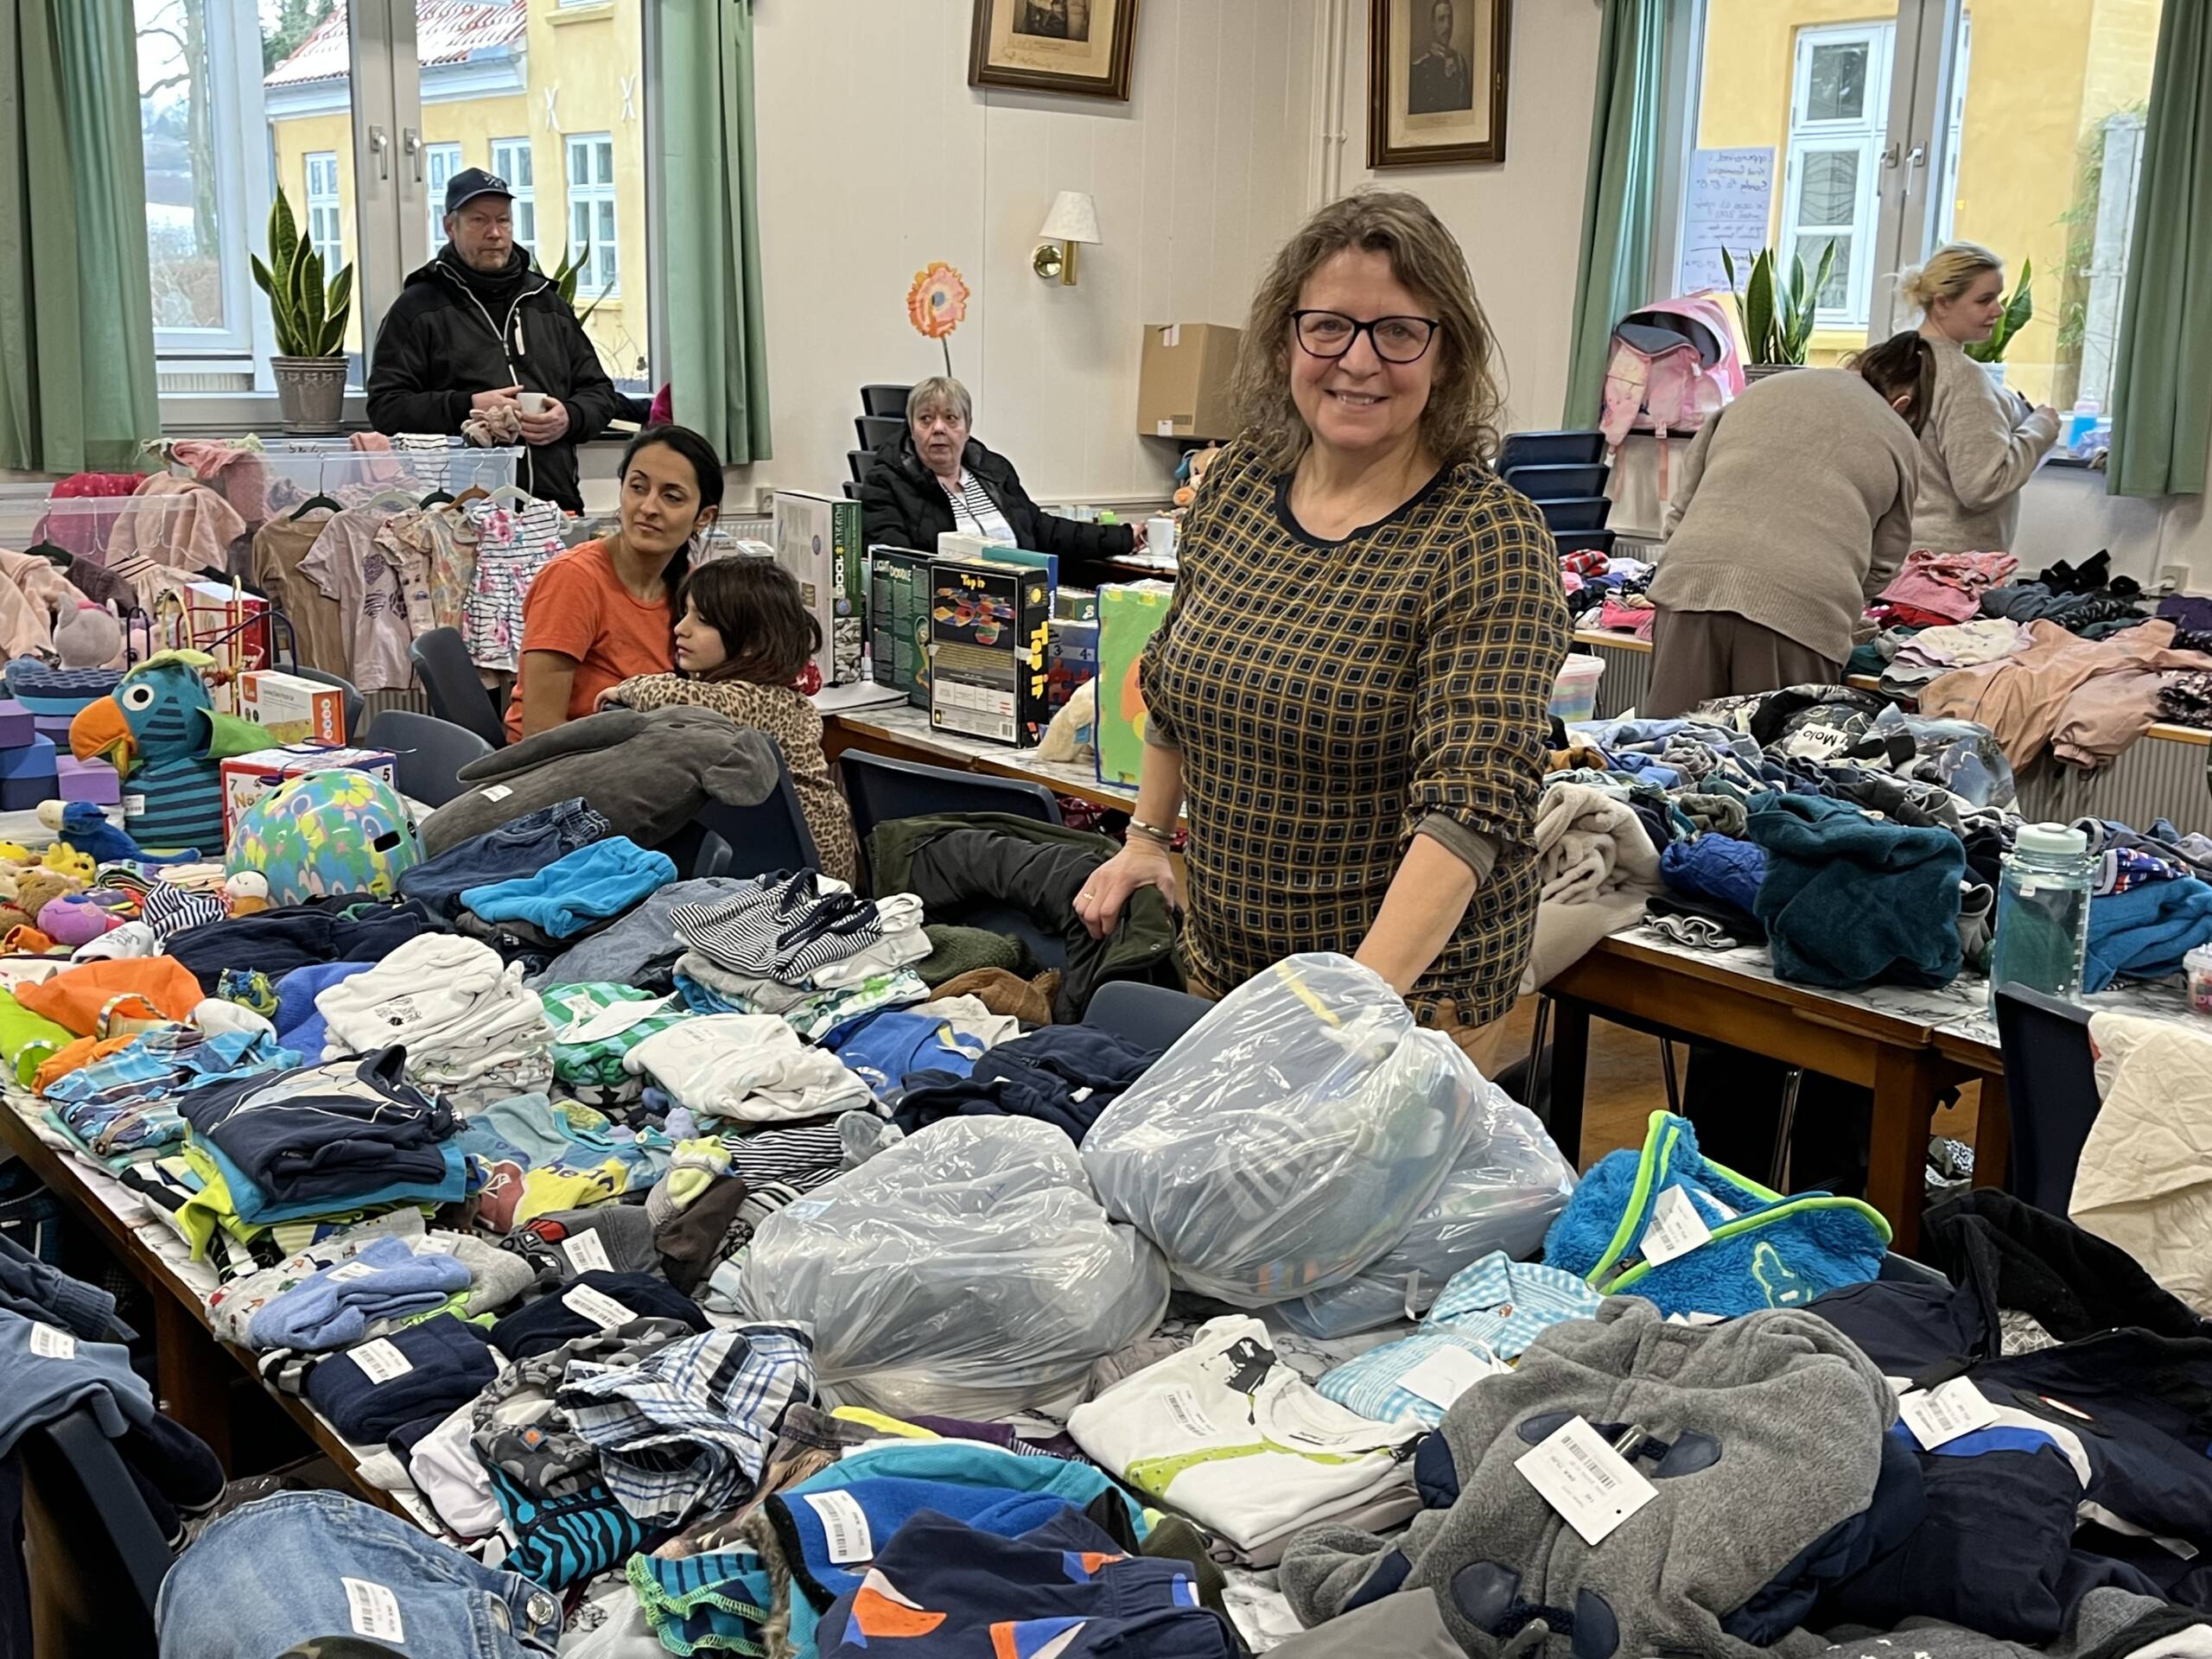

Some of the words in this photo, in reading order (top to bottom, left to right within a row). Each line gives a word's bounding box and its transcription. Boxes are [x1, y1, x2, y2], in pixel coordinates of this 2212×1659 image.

[835, 556, 845, 595] 1000
[1802, 730, 1838, 747] Molo
[382, 766, 391, 782] 5
[229, 778, 238, 791] 7
